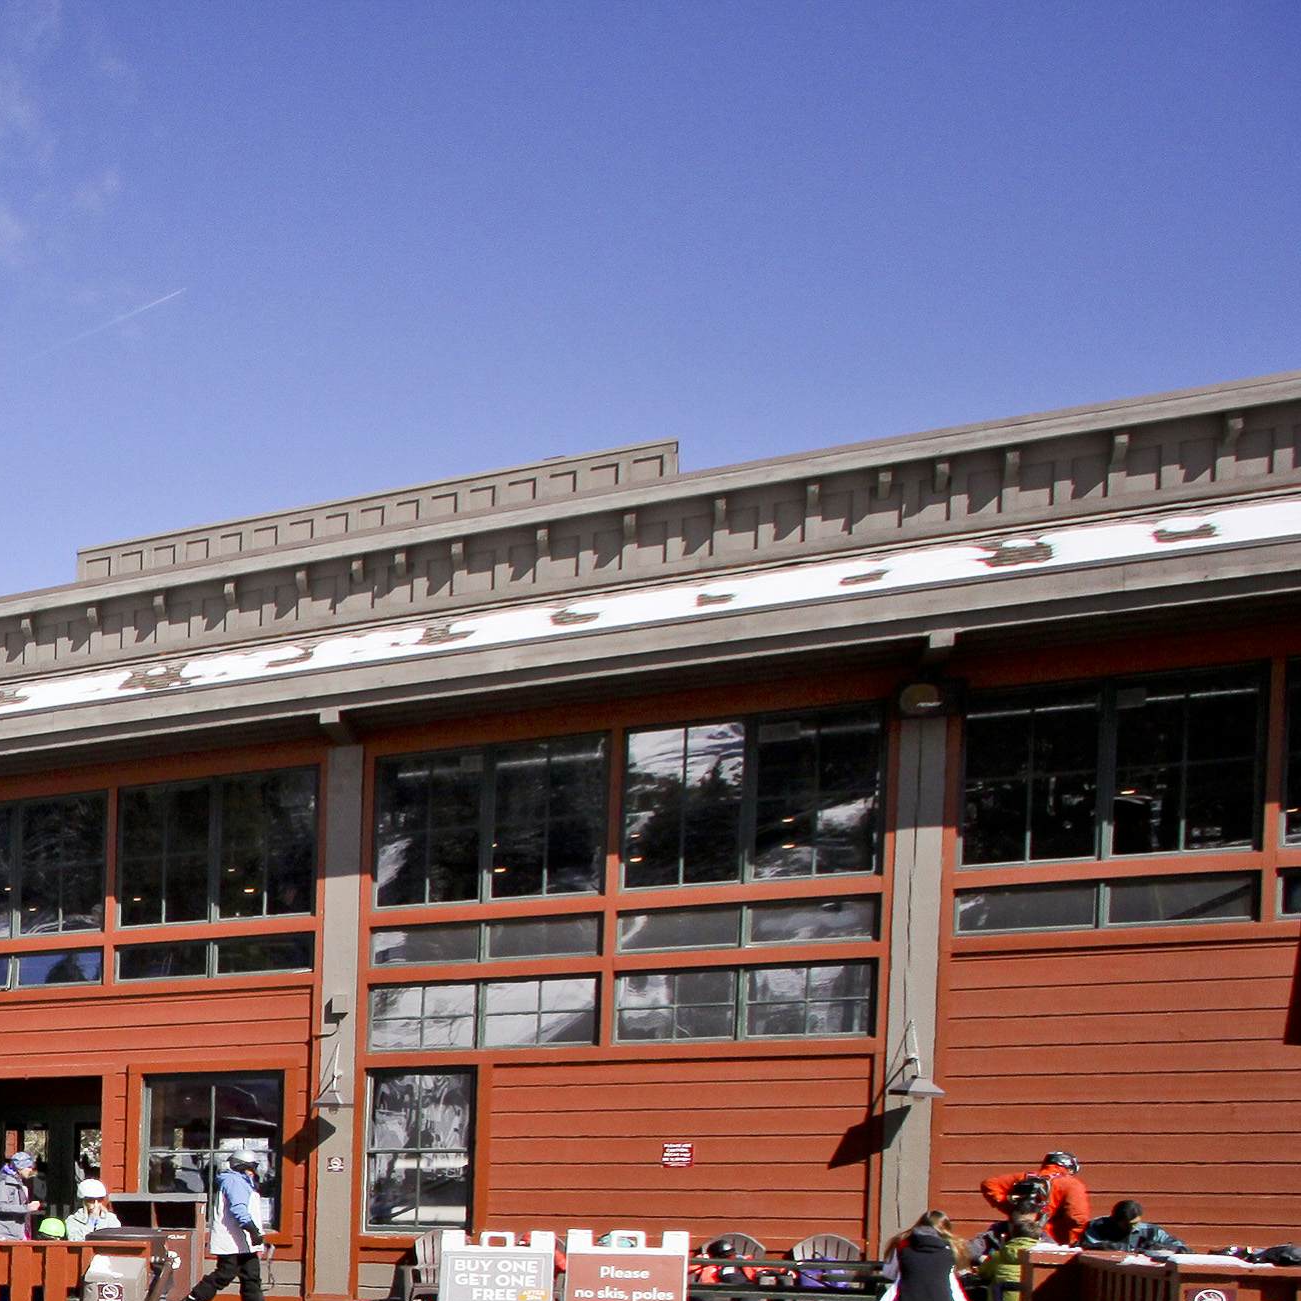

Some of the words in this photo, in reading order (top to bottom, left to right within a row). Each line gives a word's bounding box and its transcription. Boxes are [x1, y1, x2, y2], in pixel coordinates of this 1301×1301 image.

[454, 1259, 493, 1271] BUY
[497, 1260, 538, 1273] ONE
[600, 1266, 650, 1279] Please
[455, 1273, 491, 1286] GET
[495, 1274, 536, 1287] ONE
[472, 1287, 518, 1301] FREE
[574, 1289, 594, 1298] no
[597, 1285, 629, 1300] skis,
[632, 1287, 674, 1301] poles
